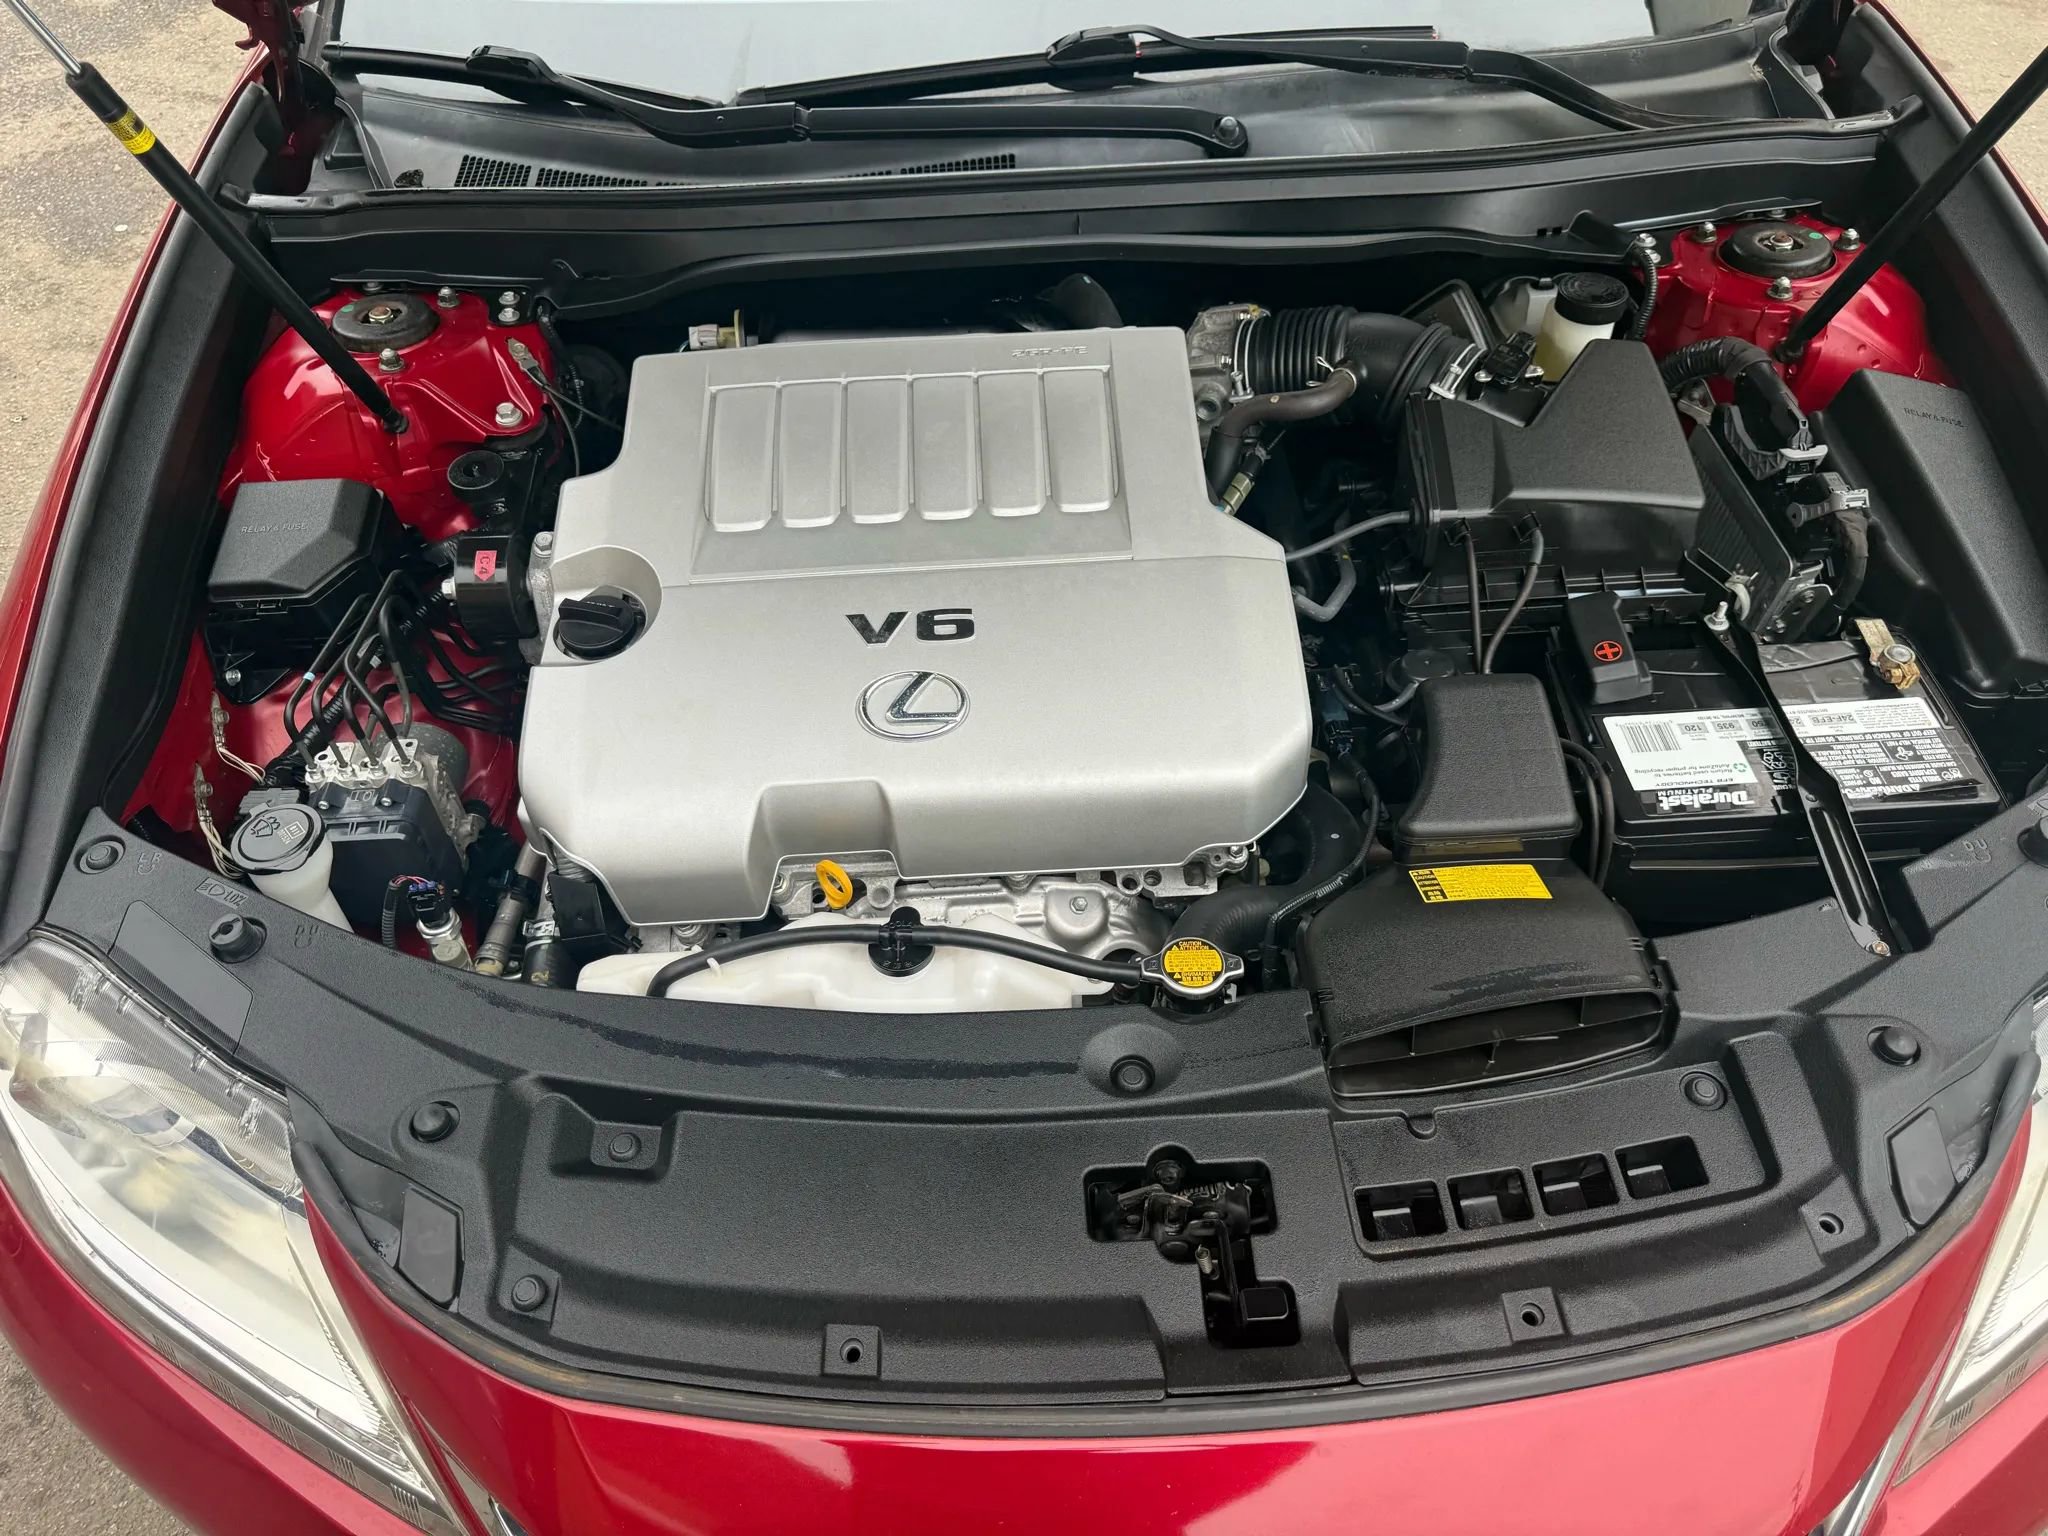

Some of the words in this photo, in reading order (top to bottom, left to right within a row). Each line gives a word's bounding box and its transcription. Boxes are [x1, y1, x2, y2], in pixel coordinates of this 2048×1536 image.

[1903, 407, 1932, 419] RELAY
[241, 525, 273, 533] RELAY
[282, 523, 307, 531] FUSE
[845, 608, 976, 646] V6
[1684, 724, 1702, 732] 120
[1716, 722, 1735, 730] 935
[1656, 779, 1714, 788] TECHNOLOGY
[1869, 776, 1882, 785] NO
[1657, 787, 1714, 798] PLATINUM
[1658, 790, 1754, 810] Duralast
